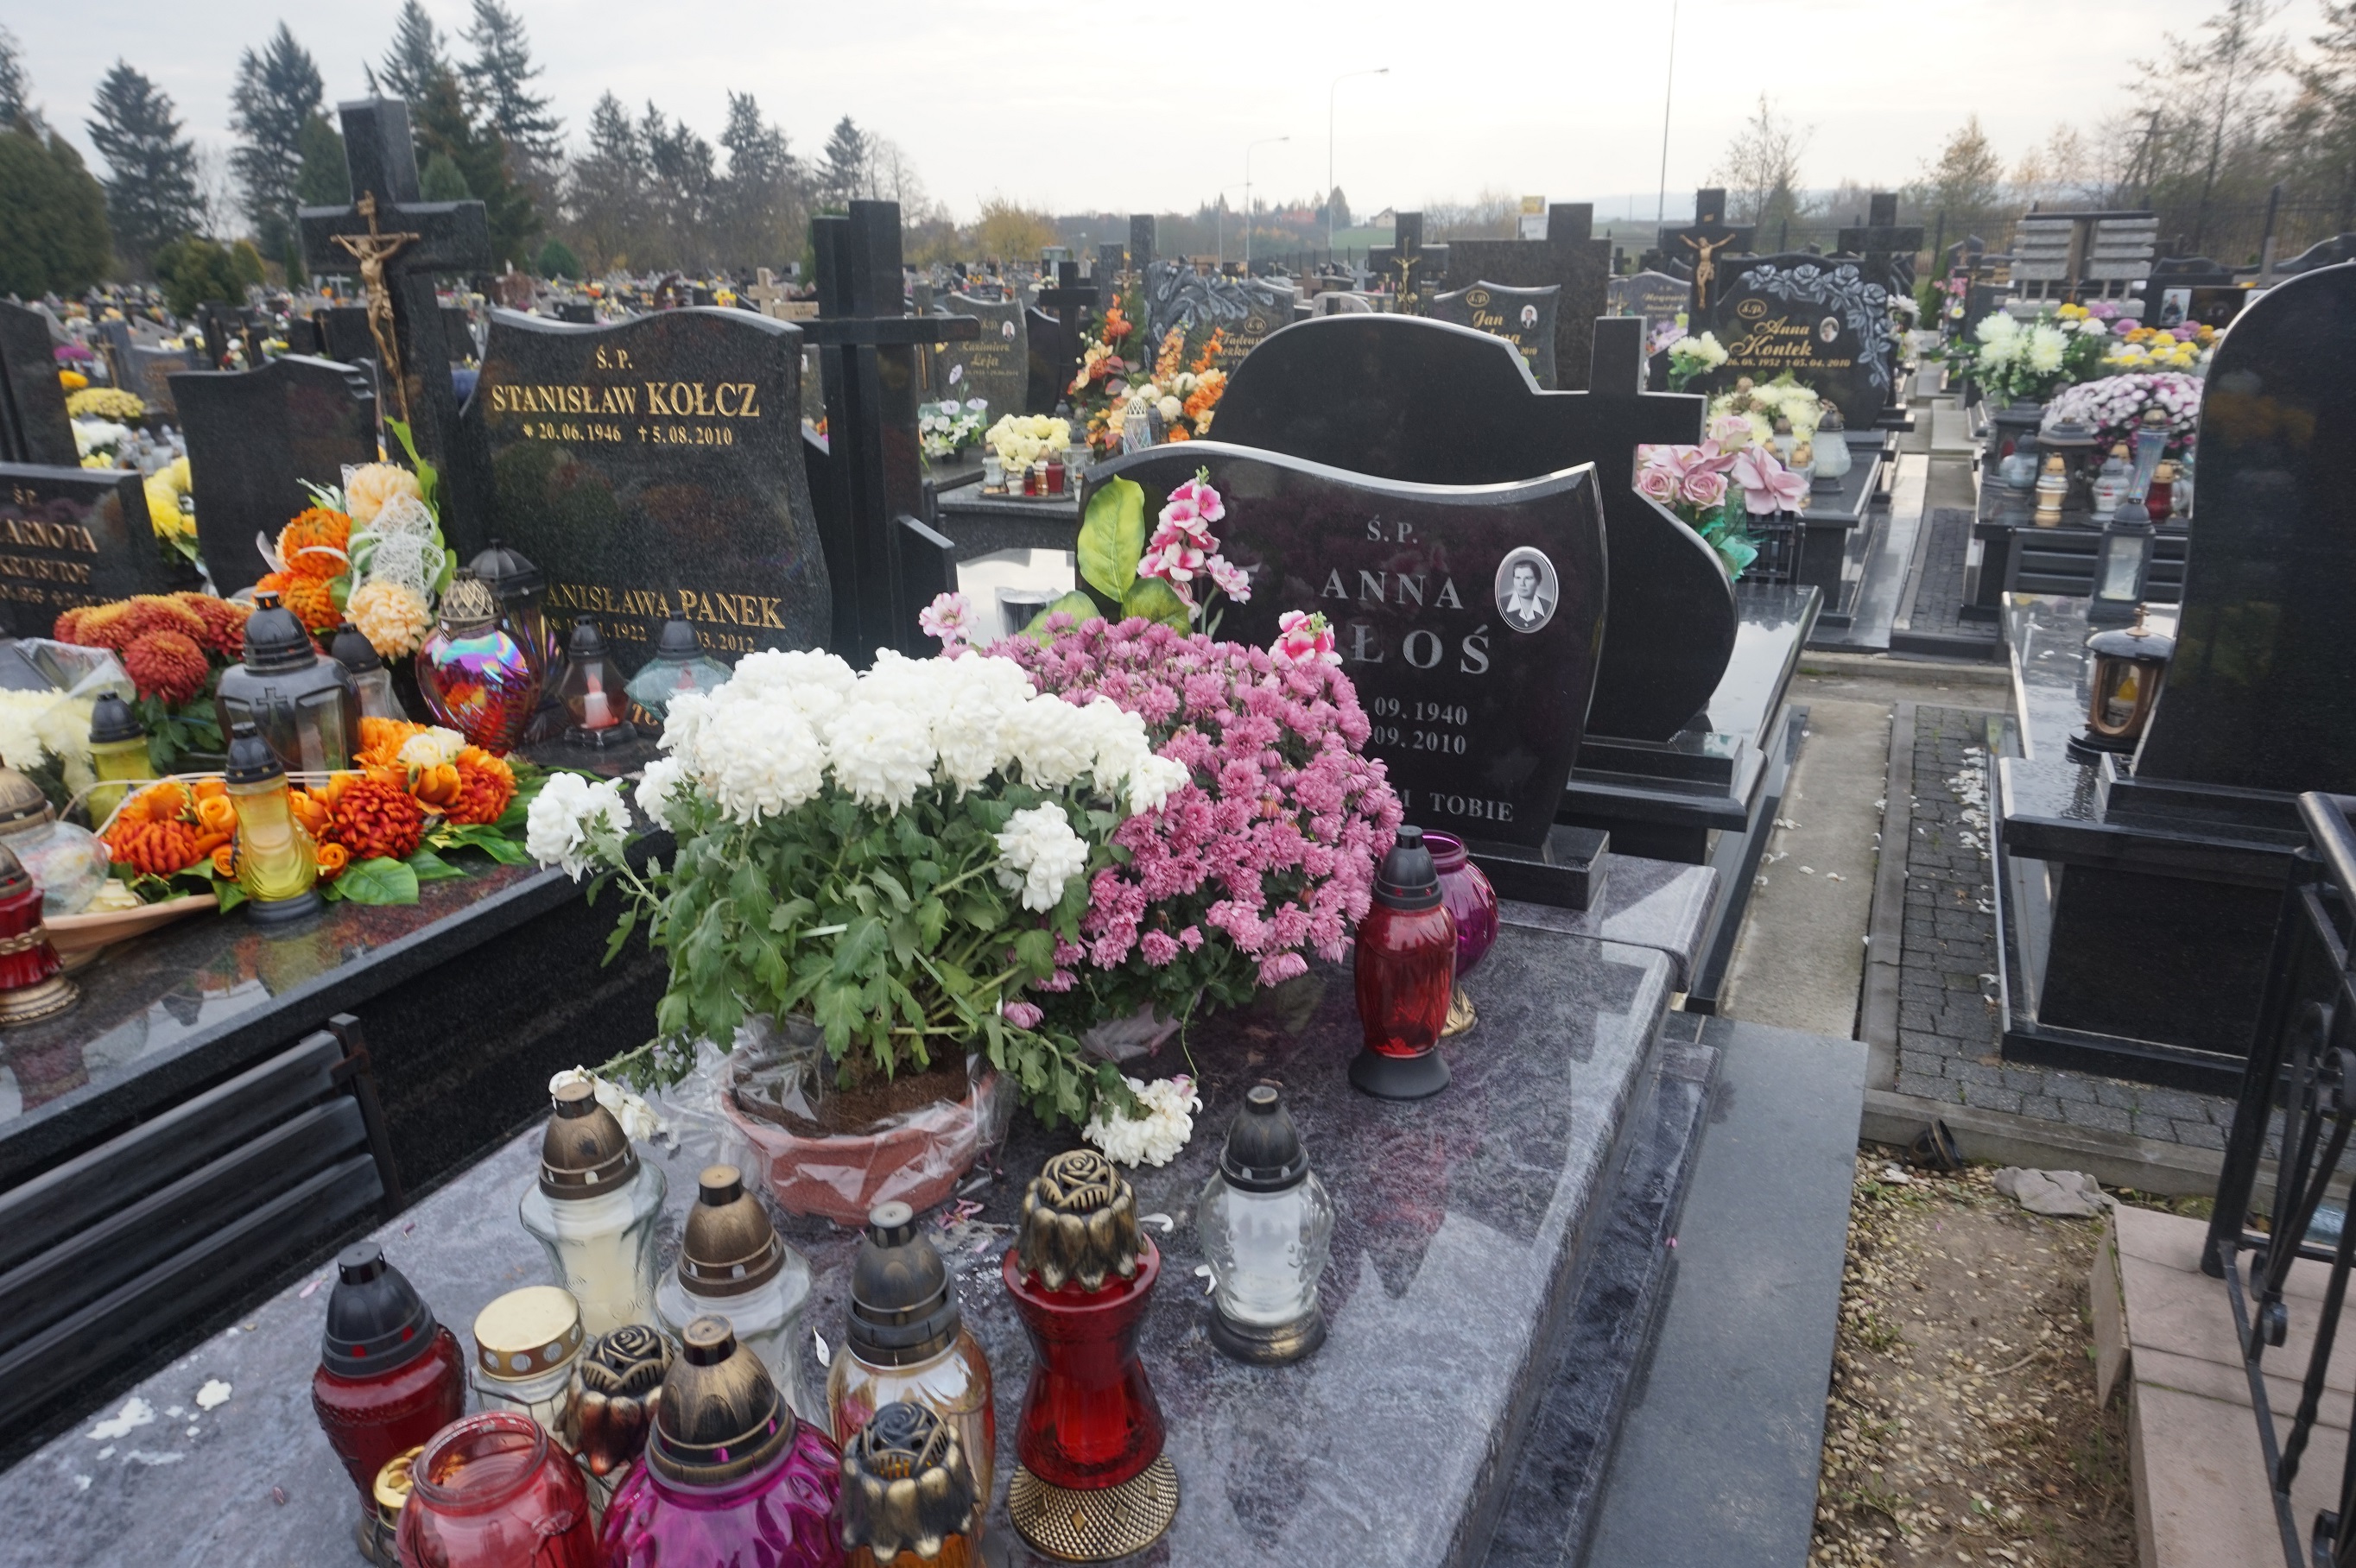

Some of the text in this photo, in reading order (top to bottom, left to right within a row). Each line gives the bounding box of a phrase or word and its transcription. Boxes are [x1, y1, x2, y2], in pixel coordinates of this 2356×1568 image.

[1472, 309, 1504, 328] Jan
[1754, 315, 1810, 335] Anna
[1729, 333, 1812, 356] Kontek
[491, 382, 760, 417] STANISŁAW KOŁCZ
[538, 421, 732, 446] 20.06.1946 5.08.2010
[0, 518, 98, 553] ARNOTA
[1320, 567, 1464, 610] ANNA
[547, 584, 786, 629] ANISŁAWA PANEK
[1351, 623, 1490, 675] ŁOŚ
[1374, 696, 1468, 726] 09.1940
[1373, 725, 1467, 756] 09.2010
[1429, 793, 1513, 822] TOBIE
